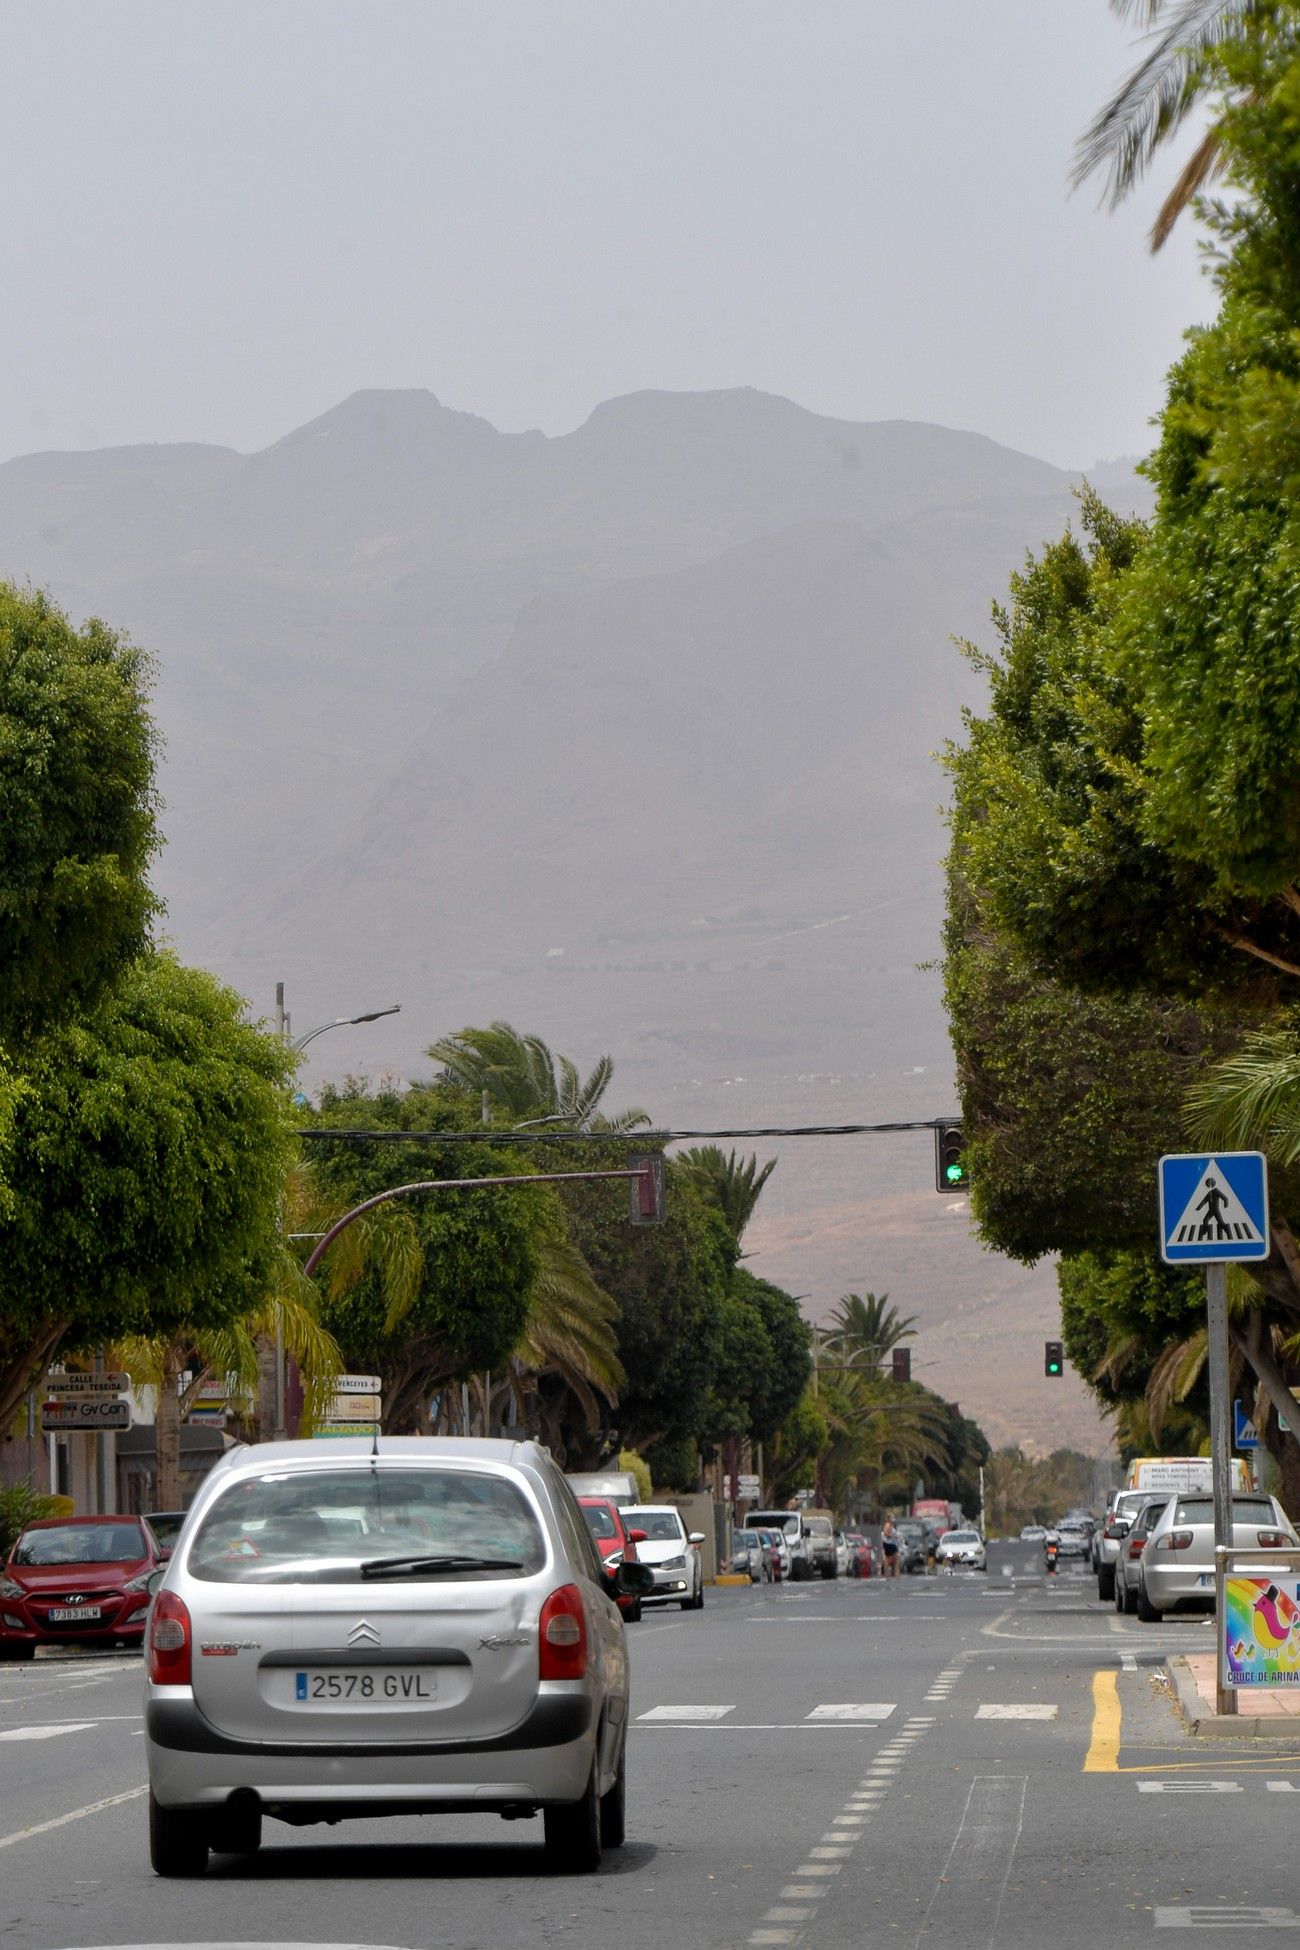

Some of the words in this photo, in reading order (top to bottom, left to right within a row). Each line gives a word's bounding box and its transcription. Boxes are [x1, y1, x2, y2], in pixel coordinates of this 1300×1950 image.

[46, 1384, 86, 1392] PRINCESA
[1228, 1672, 1255, 1682] CRUCE
[1258, 1672, 1269, 1682] DE
[312, 1675, 374, 1698] 2578
[384, 1675, 430, 1697] GVL
